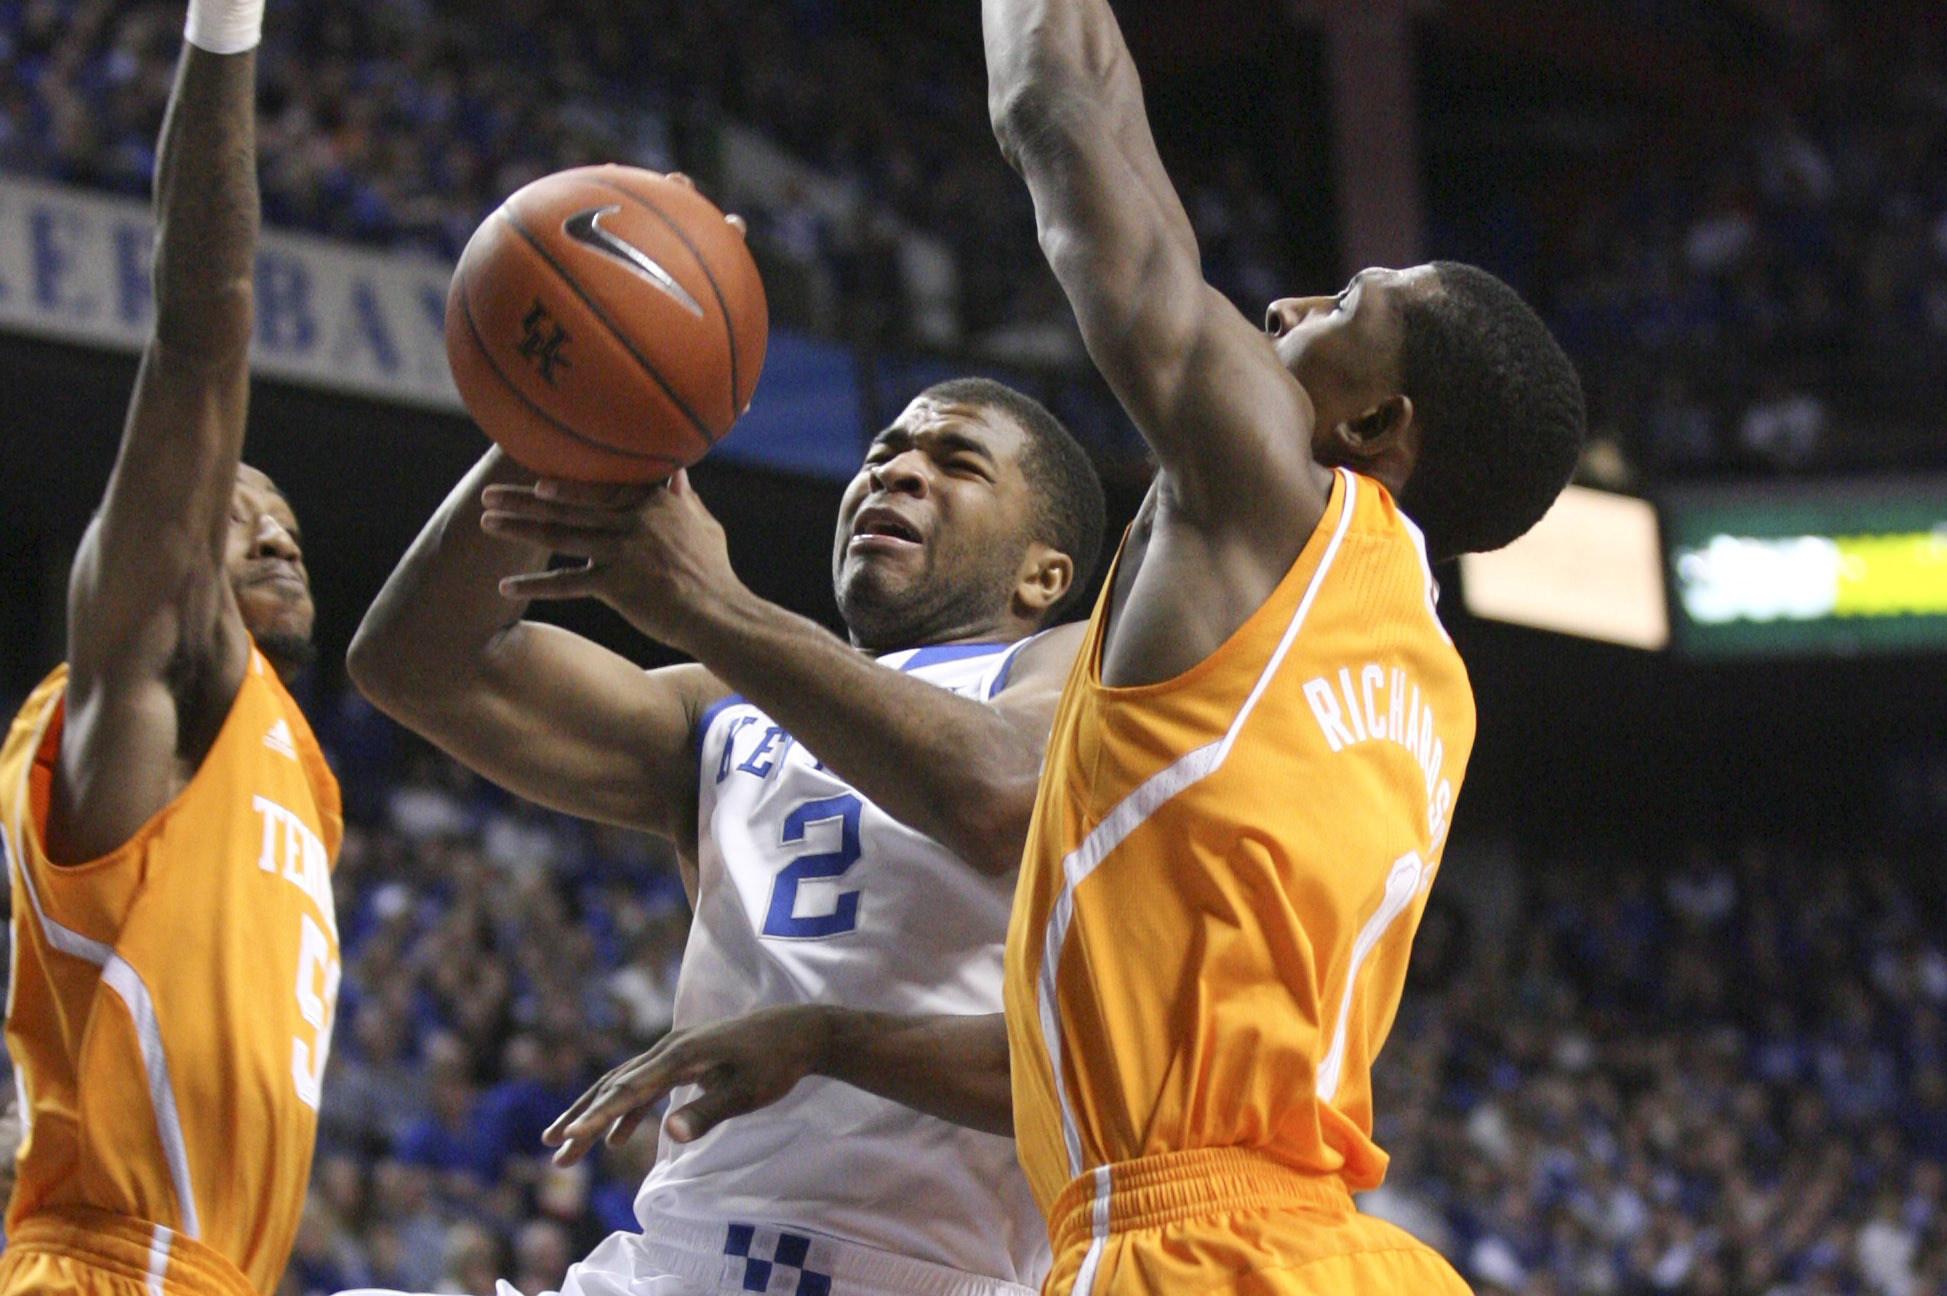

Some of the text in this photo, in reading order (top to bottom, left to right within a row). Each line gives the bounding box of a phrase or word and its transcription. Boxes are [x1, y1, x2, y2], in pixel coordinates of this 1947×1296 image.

[716, 716, 815, 784] KE
[1302, 664, 1451, 896] RICHARDS
[759, 793, 862, 938] 2
[291, 912, 341, 1111] 5
